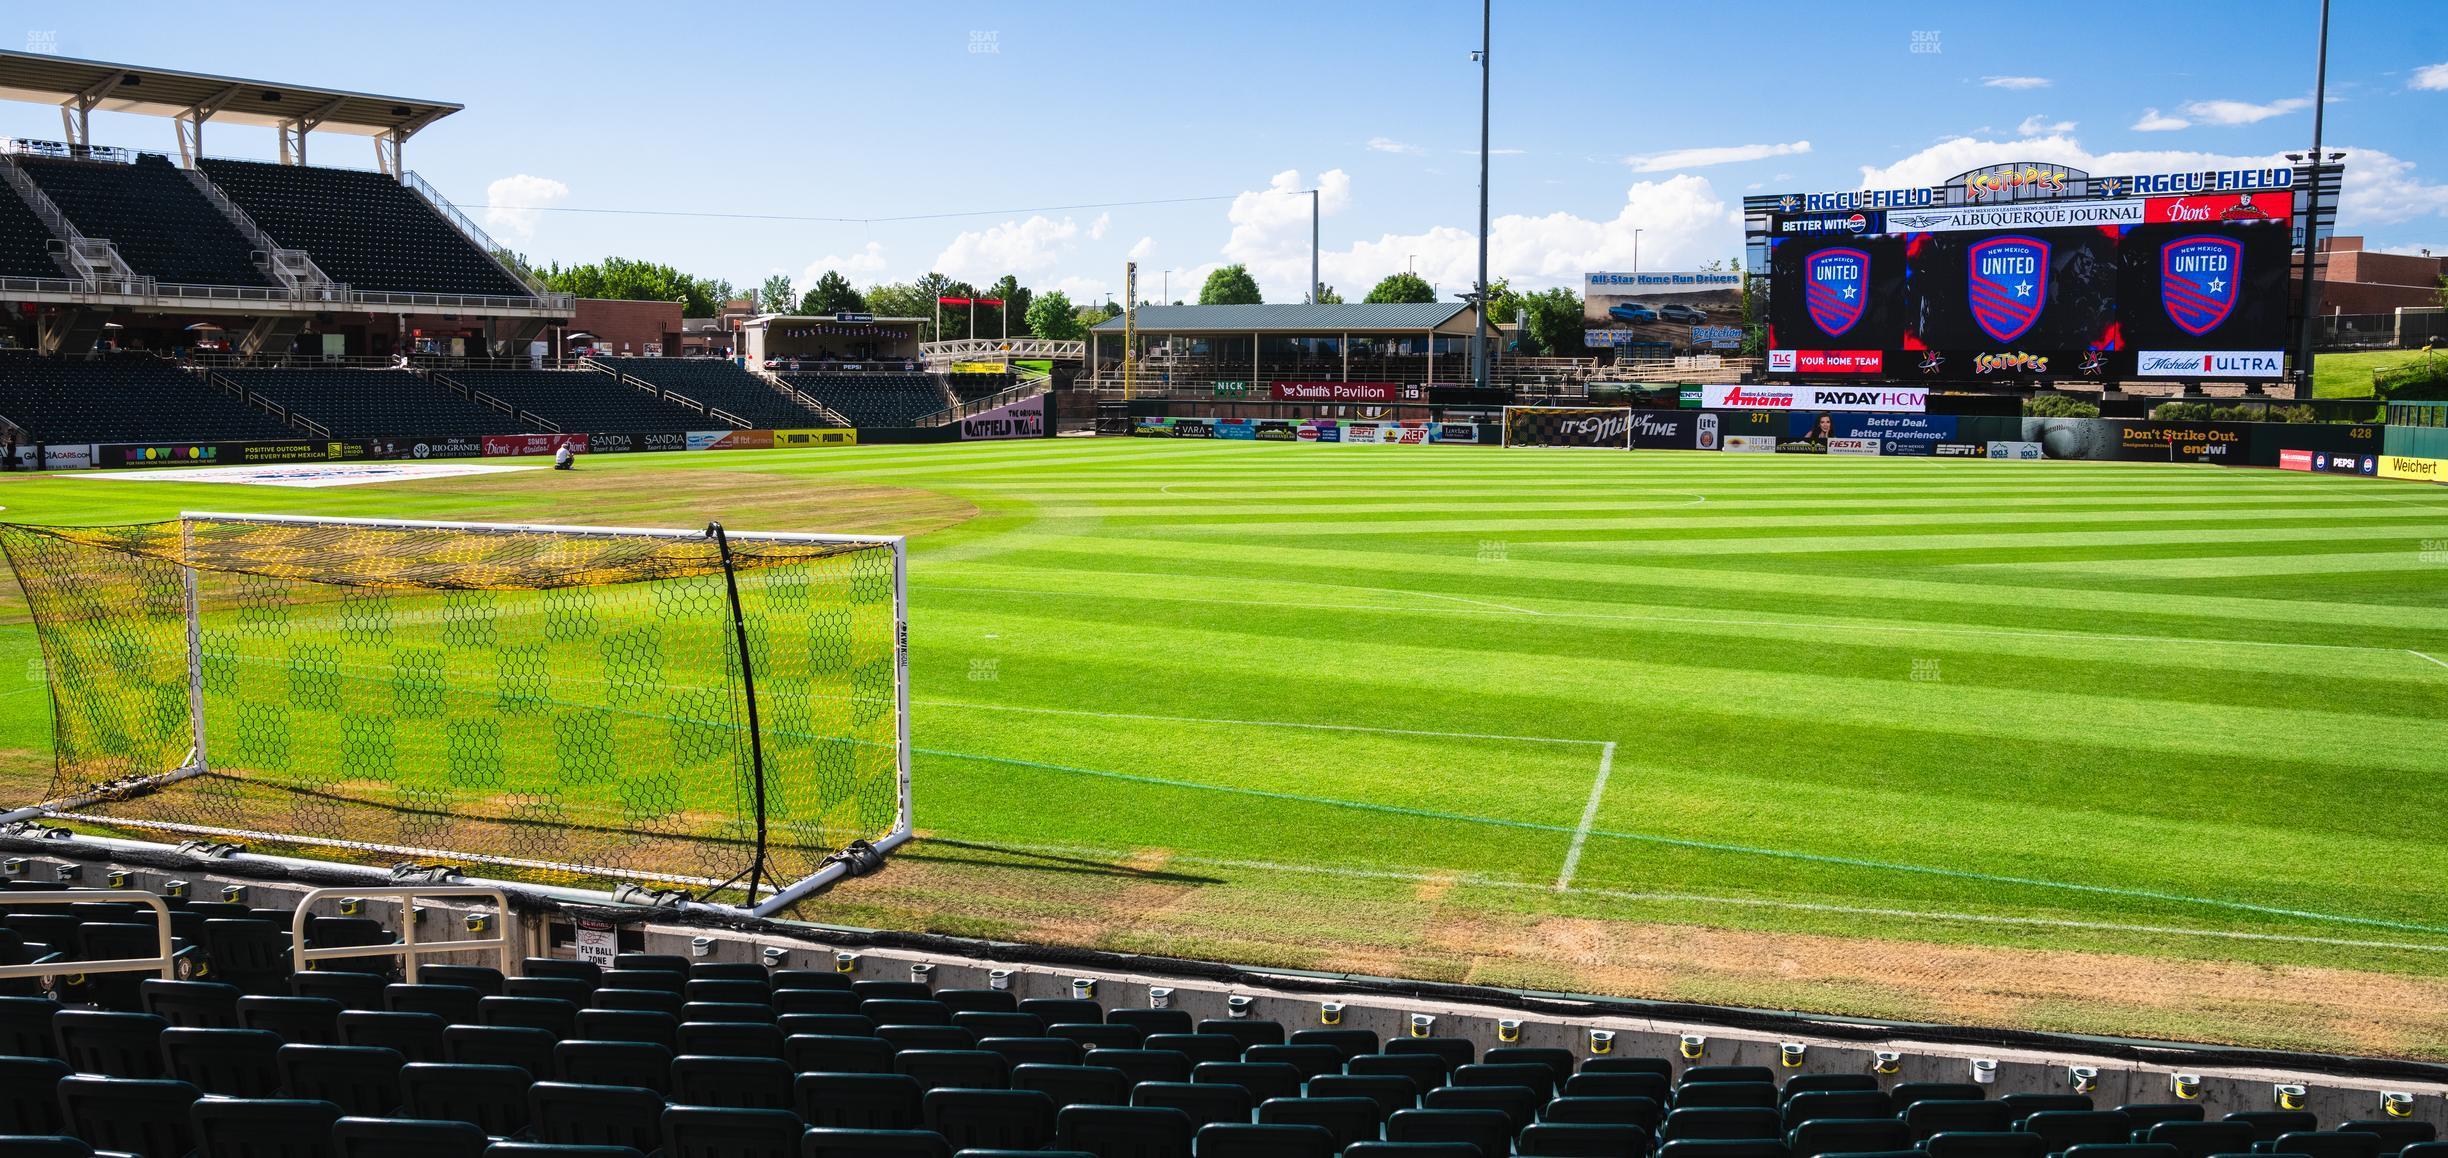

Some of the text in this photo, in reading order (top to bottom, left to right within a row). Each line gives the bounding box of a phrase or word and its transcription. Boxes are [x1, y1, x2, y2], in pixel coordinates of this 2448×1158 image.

[1964, 166, 2066, 200] ISOTOPES
[2131, 167, 2294, 194] RGCU FIELD
[1805, 188, 1932, 211] RGCU FIELD
[2167, 198, 2210, 222] Dion's
[1951, 207, 2142, 226] ALBUQUERQUE JOURNAL
[1782, 220, 1850, 232] BETTER WITH
[2181, 246, 2195, 254] NEW
[1982, 256, 2034, 274] UNITED
[2175, 255, 2227, 272] UNITED
[1817, 266, 1858, 280] UNITED
[1591, 274, 1739, 284] All-Star Home Run Drivers
[1693, 326, 1742, 341] Perfection
[1772, 354, 1790, 362] TLC
[1855, 358, 1878, 366] TEAM
[1974, 351, 2048, 374] ISOTOPES
[2142, 357, 2278, 371] Michelob ULTRA
[1218, 382, 1243, 390] NICK
[1296, 384, 1384, 398] Smith's Pavilion
[1405, 390, 1418, 398] 19
[1723, 387, 1792, 406] Amana
[1814, 392, 1926, 406] PAYDAY HCM
[1700, 418, 1716, 429] Lite
[1752, 413, 1769, 423] 371
[1867, 418, 1928, 427] Better Deal.
[964, 419, 1042, 436] OATFIELD WALL
[1183, 426, 1205, 434] VARA
[1560, 413, 1677, 442] IT'S Miller TIME
[644, 434, 685, 444] SANDIA
[788, 434, 809, 443] PUMA
[823, 434, 844, 442] PUMA
[1405, 430, 1424, 440] RED
[1850, 429, 1882, 438] Better
[2123, 428, 2238, 442] Don't Strike Out.
[2350, 428, 2372, 439] 428
[565, 437, 586, 452] Dion's
[591, 436, 632, 446] SANDIA
[1829, 440, 1862, 448] FIESTA
[485, 439, 510, 455] Dion's
[2183, 444, 2226, 455] endwi
[24, 452, 90, 460] GACIACARS.COM
[126, 447, 216, 460] MEOW WOLF
[2333, 458, 2354, 468] PEPSI
[2393, 458, 2436, 474] Weichert
[581, 946, 613, 956] FLY BALL
[588, 956, 606, 965] ZONE
